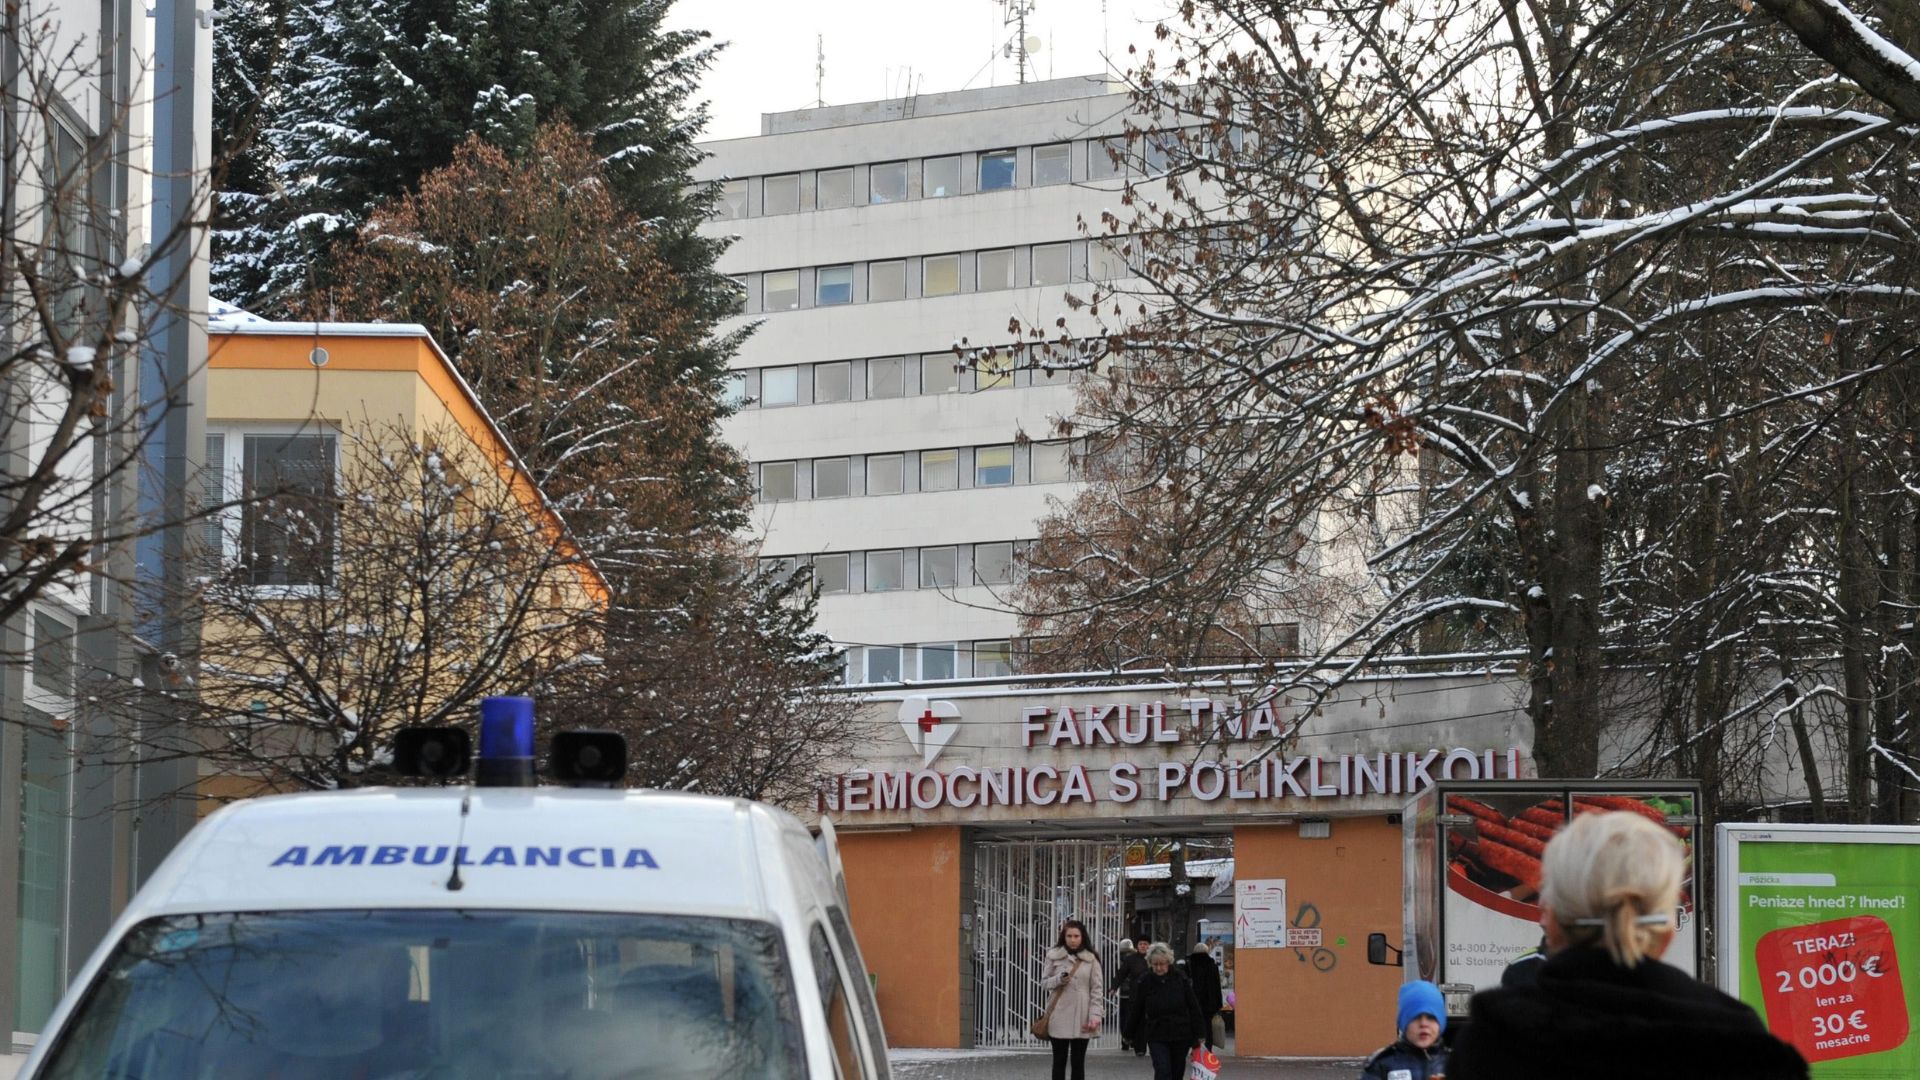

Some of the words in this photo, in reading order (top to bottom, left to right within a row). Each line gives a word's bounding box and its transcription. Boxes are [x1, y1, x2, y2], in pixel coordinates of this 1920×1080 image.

[817, 764, 1096, 811] NEMOCNICA
[1109, 762, 1144, 803] S
[1158, 747, 1520, 802] POLIKLINIKOU
[268, 846, 662, 870] AMBULANCIA
[1748, 894, 1805, 909] Peniaze
[1448, 943, 1487, 954] 34-300
[1792, 932, 1857, 955] TERAZ!
[1816, 996, 1836, 1008] len
[1839, 993, 1854, 1004] za
[1815, 1031, 1871, 1051] mesačne
